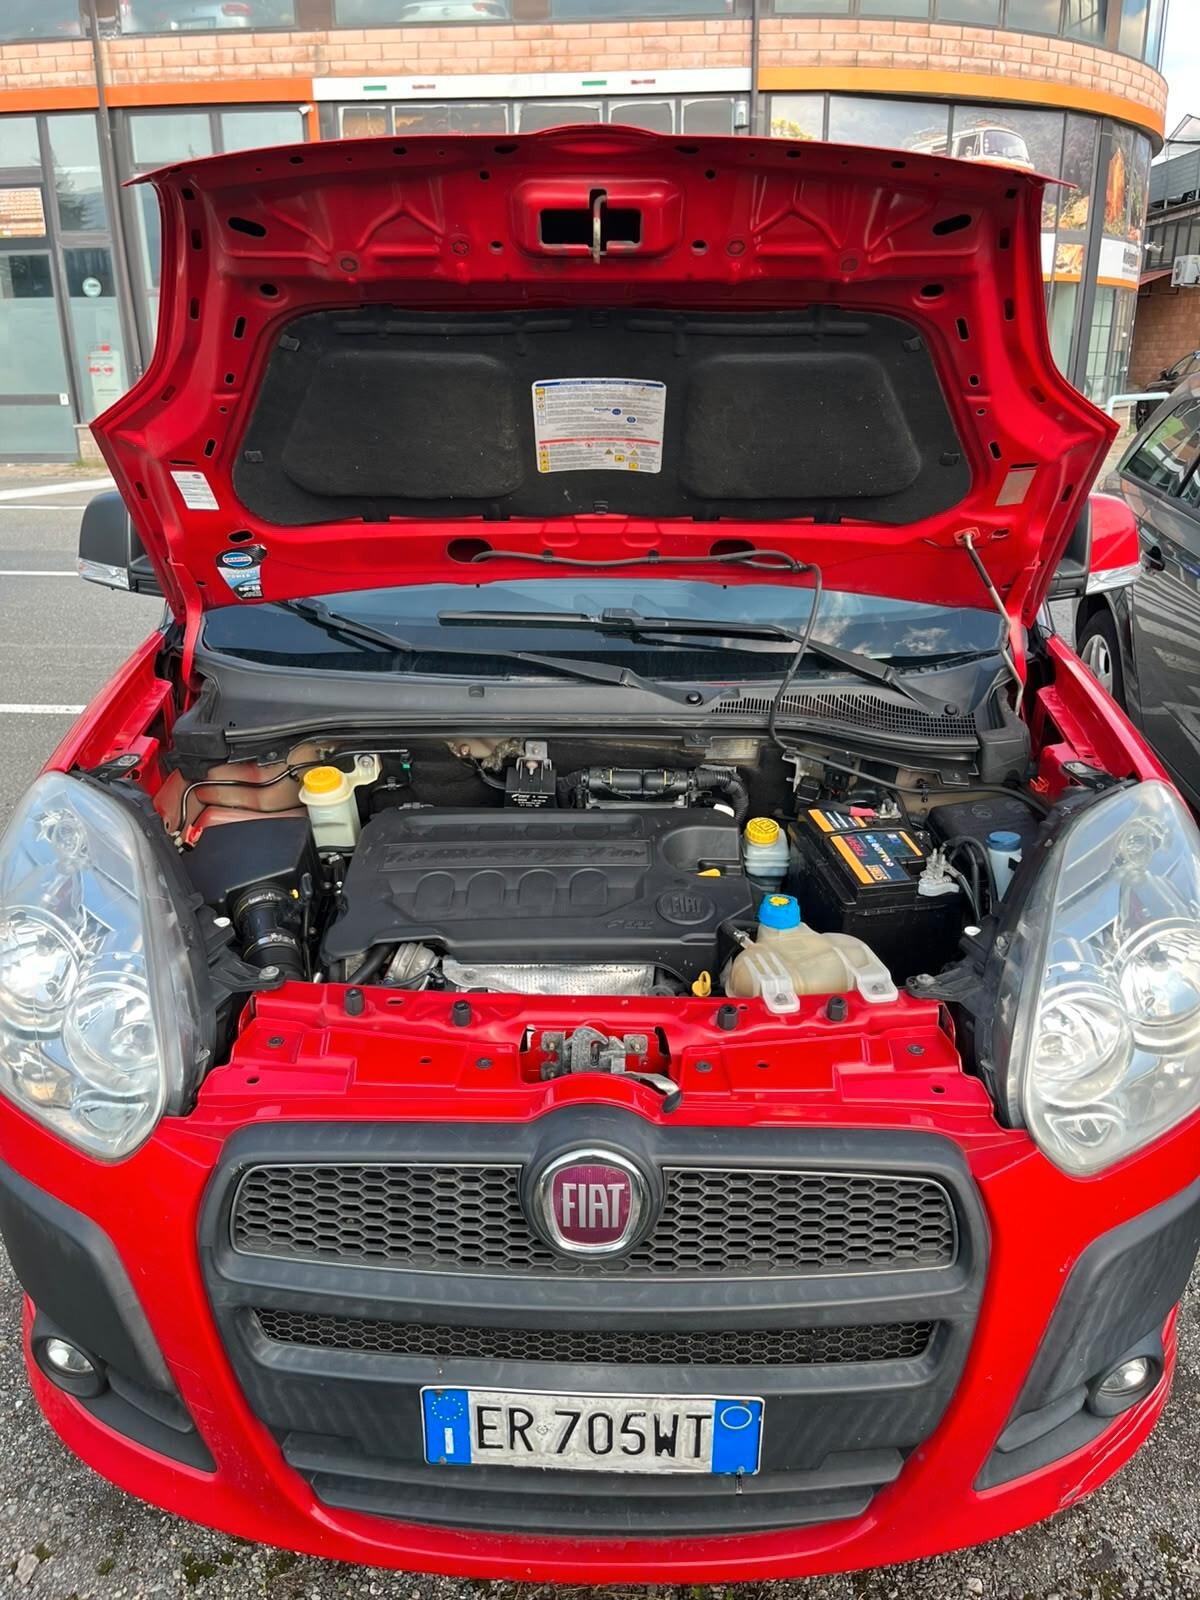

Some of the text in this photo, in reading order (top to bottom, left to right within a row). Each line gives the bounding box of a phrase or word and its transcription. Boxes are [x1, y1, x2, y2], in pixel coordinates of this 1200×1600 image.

[671, 895, 703, 914] FIAT
[562, 1183, 625, 1228] FIAT
[476, 1405, 712, 1458] ER 705WT
